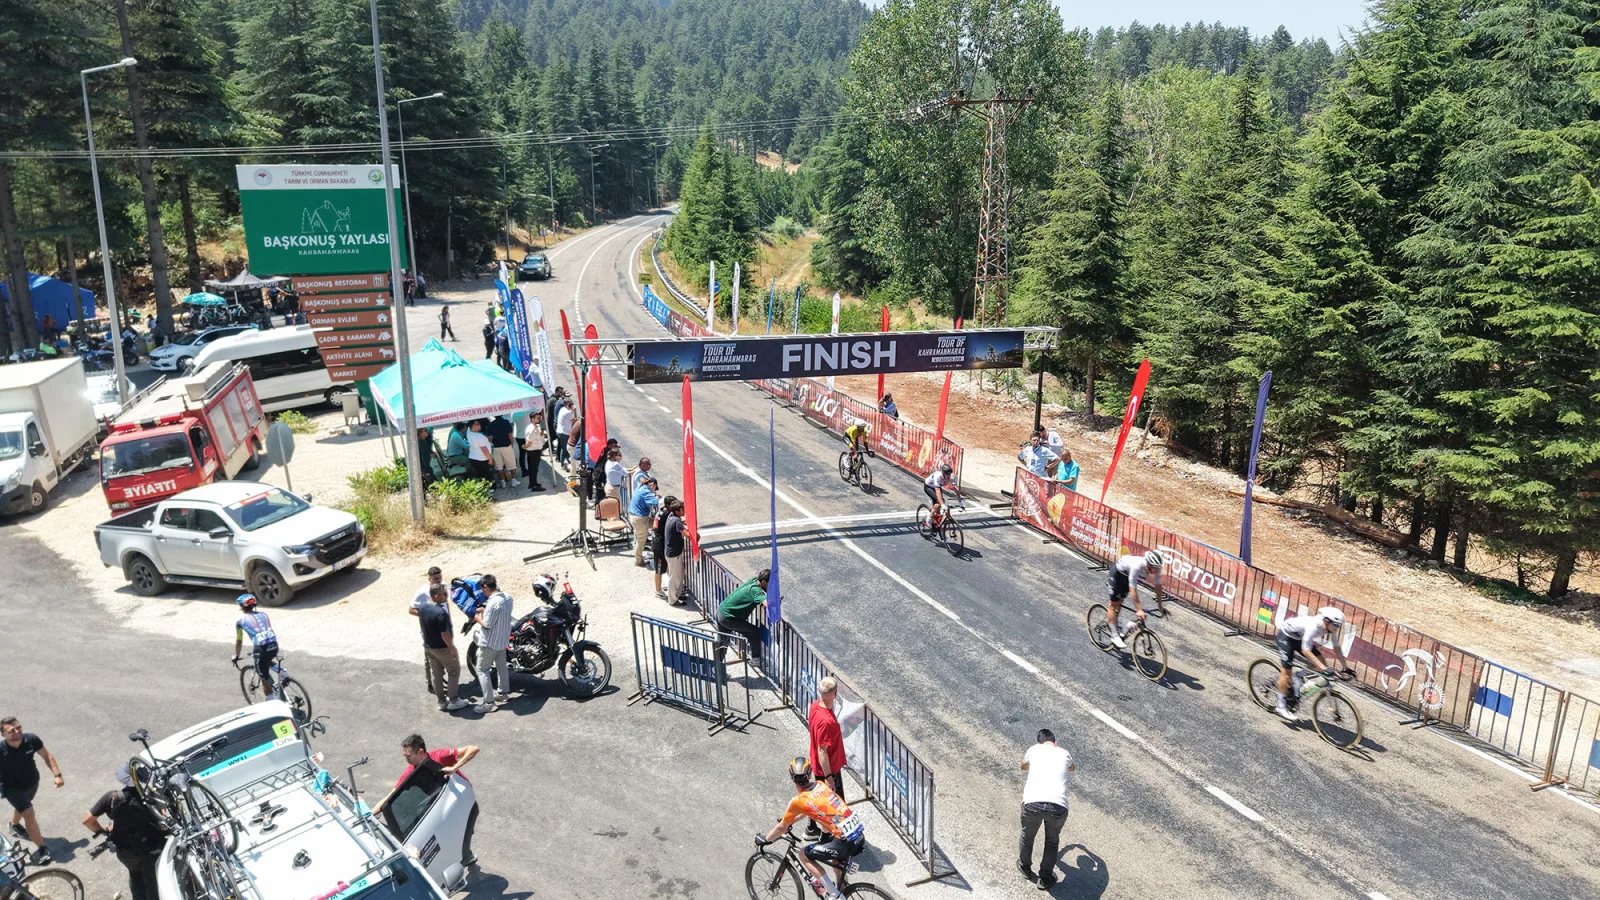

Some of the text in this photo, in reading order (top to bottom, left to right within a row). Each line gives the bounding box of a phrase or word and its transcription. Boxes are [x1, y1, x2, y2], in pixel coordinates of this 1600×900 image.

[264, 233, 390, 249] BAŞKONUŞ YAYLASI
[297, 280, 332, 288] BAŞKONUŞ
[305, 299, 340, 307] BAŞKONUŞ
[938, 339, 955, 348] TOUR
[956, 338, 966, 348] OF
[704, 346, 736, 356] TOUR OF
[782, 340, 897, 372] FINISH
[332, 370, 357, 378] MARKET
[815, 394, 840, 418] UCI
[280, 725, 288, 735] 5
[228, 755, 248, 766] TEAM
